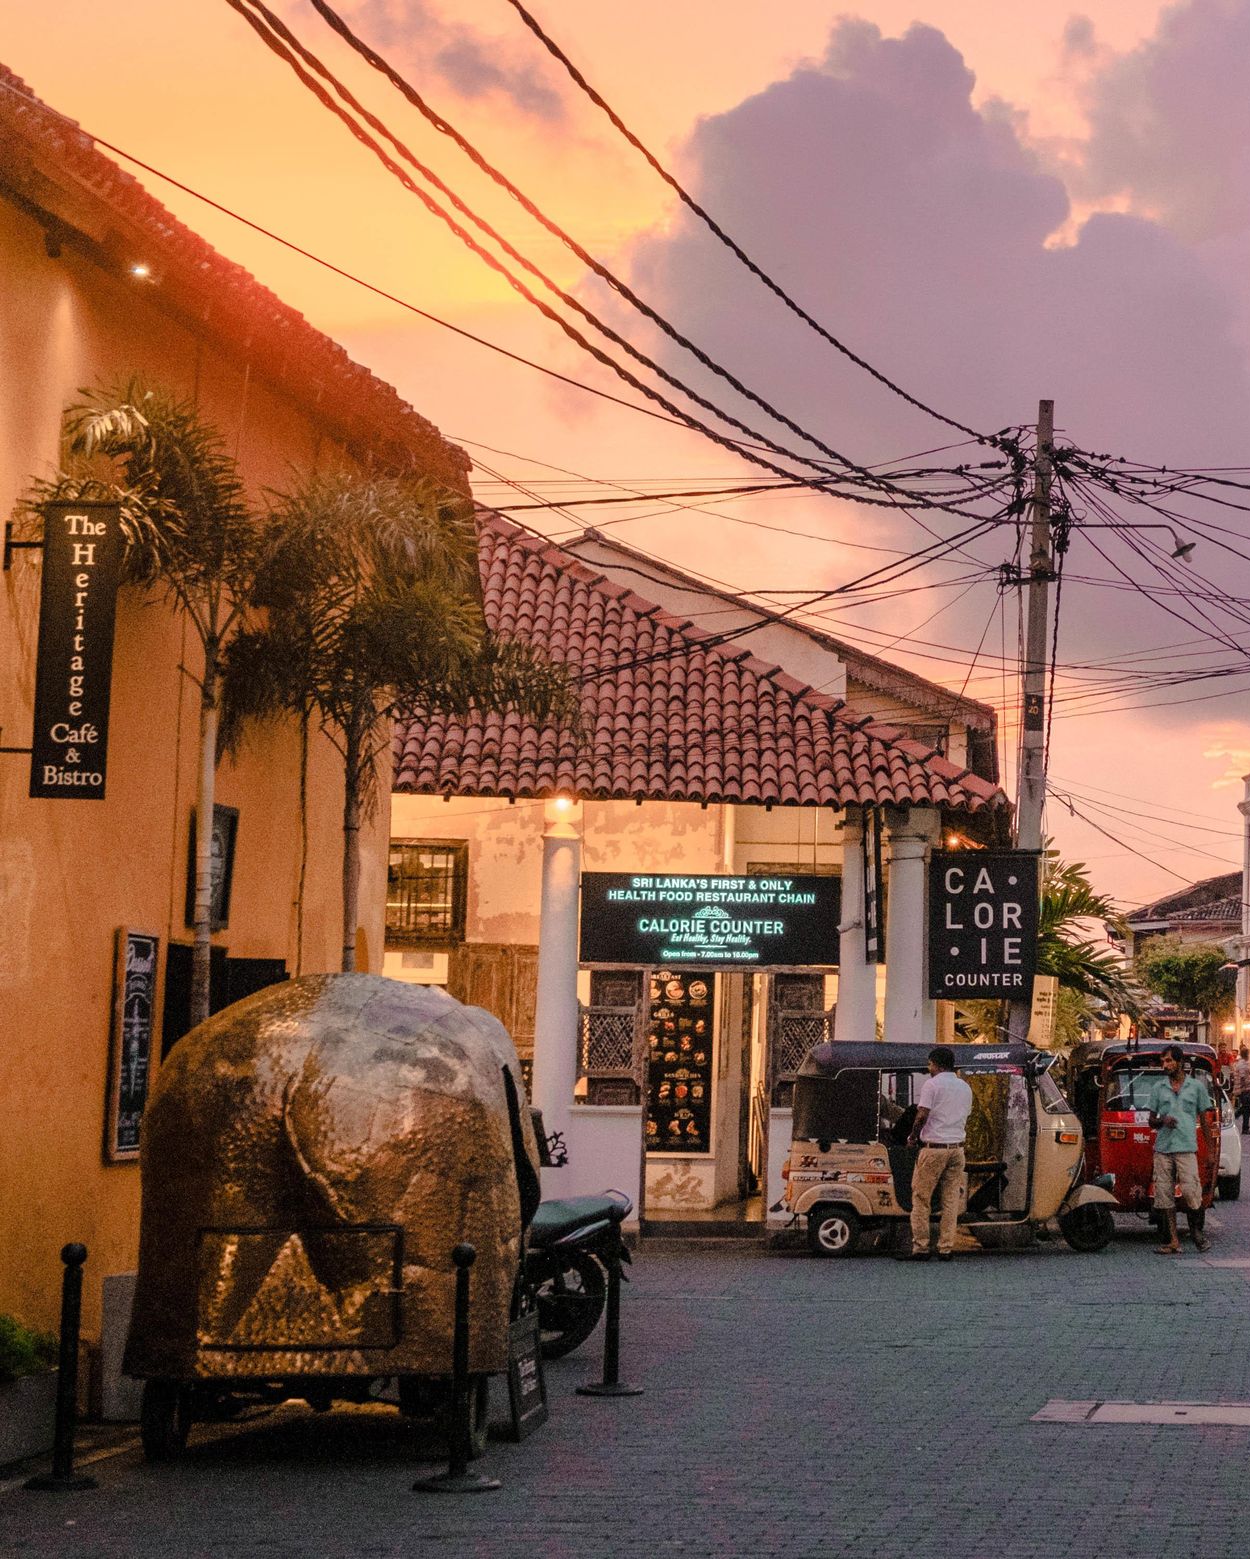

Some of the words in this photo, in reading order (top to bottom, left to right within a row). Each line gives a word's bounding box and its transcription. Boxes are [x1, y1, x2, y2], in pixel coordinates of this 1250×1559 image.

[64, 515, 107, 536] The
[68, 543, 97, 717] Heritage
[50, 722, 99, 743] Café
[65, 747, 81, 763] &
[42, 765, 103, 786] Bistro
[632, 877, 653, 888] SRI
[656, 878, 708, 890] LANKA'S
[711, 879, 746, 890] FIRST
[748, 880, 757, 890] &
[760, 880, 793, 891] ONLY
[608, 890, 656, 901] HEALTH
[660, 891, 693, 901] FOOD
[696, 892, 776, 903] RESTAURANT
[778, 893, 816, 904] CHAIN
[639, 919, 706, 933] CALORIE
[710, 920, 784, 934] COUNTER
[670, 933, 682, 942] Eat
[710, 934, 726, 945] Stay
[662, 950, 681, 959] Open
[681, 950, 697, 958] from
[724, 951, 732, 959] to
[944, 973, 1023, 986] COUNTER
